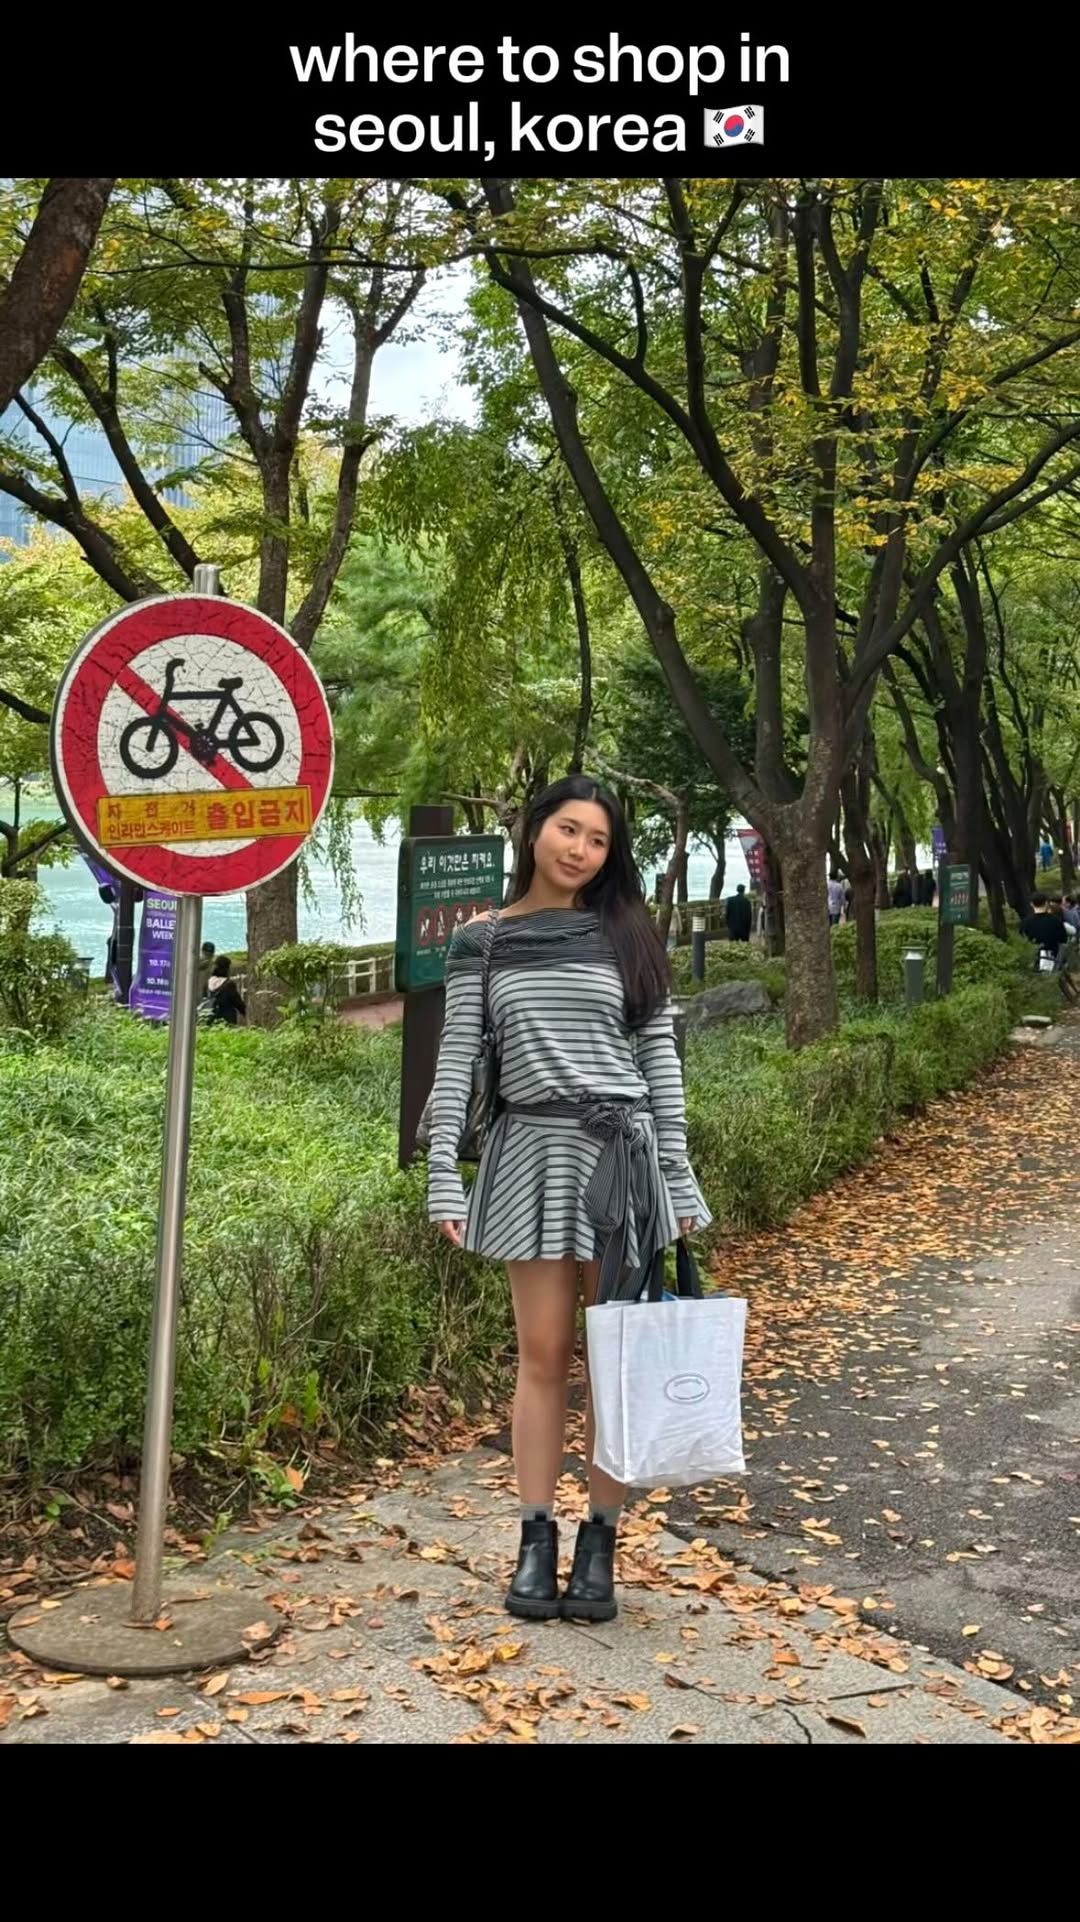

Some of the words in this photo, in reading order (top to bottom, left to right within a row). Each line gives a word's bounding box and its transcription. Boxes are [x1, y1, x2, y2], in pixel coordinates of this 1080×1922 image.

[206, 797, 305, 830] 출입금지
[420, 856, 436, 874] 우리
[146, 918, 177, 930] BALLE
